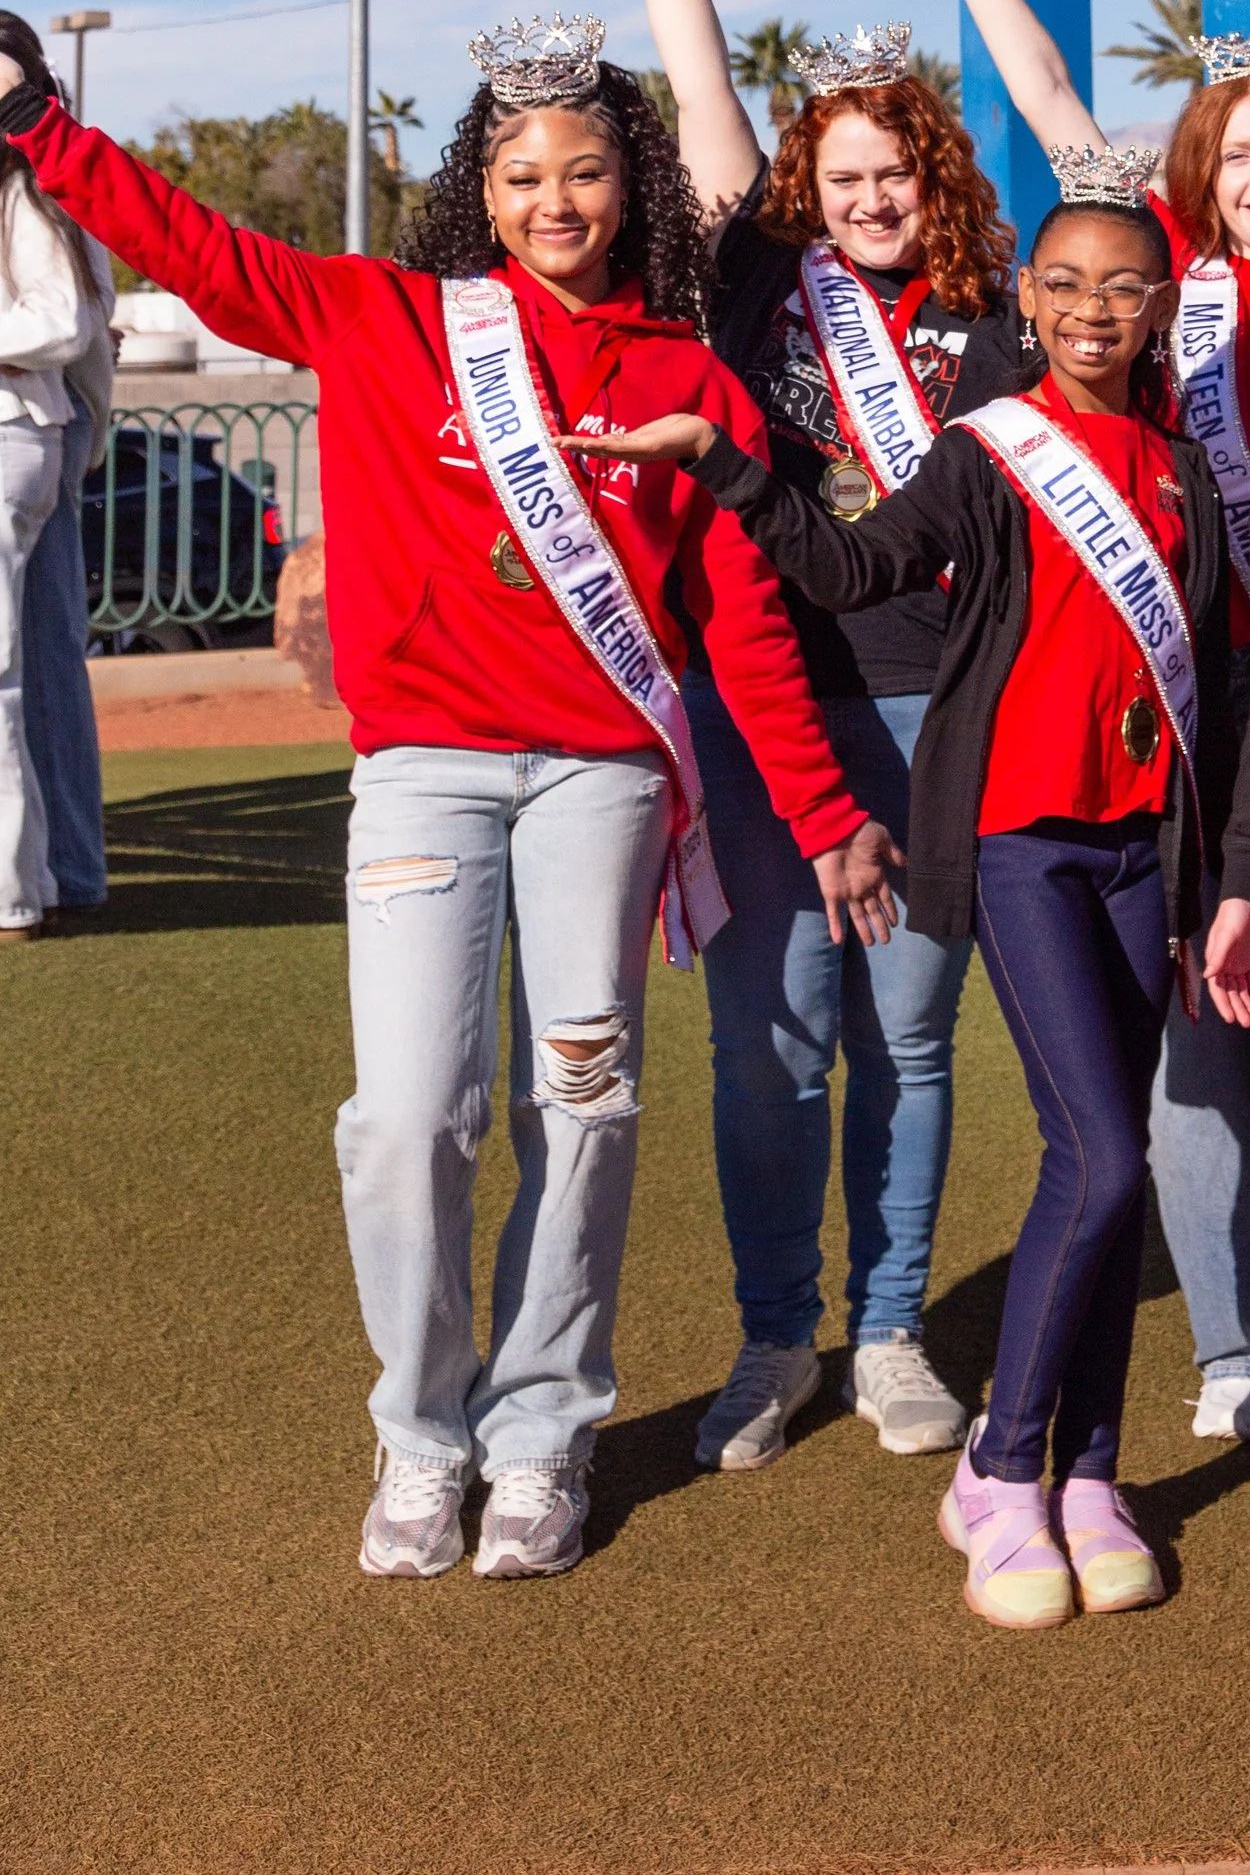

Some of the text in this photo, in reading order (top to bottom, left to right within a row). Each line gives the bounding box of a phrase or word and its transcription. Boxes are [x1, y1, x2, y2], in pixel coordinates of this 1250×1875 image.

[817, 276, 880, 380] NATIONAL
[1183, 303, 1224, 358] MISS
[466, 348, 522, 445] JUNIOR
[1185, 363, 1226, 441] TEEN
[498, 443, 563, 529] MISS
[1213, 450, 1248, 477] of
[546, 535, 596, 563] of
[1041, 464, 1131, 569] LITTLE
[1114, 559, 1172, 649] MISS
[1163, 654, 1186, 682] of
[568, 572, 652, 703] AMERICA
